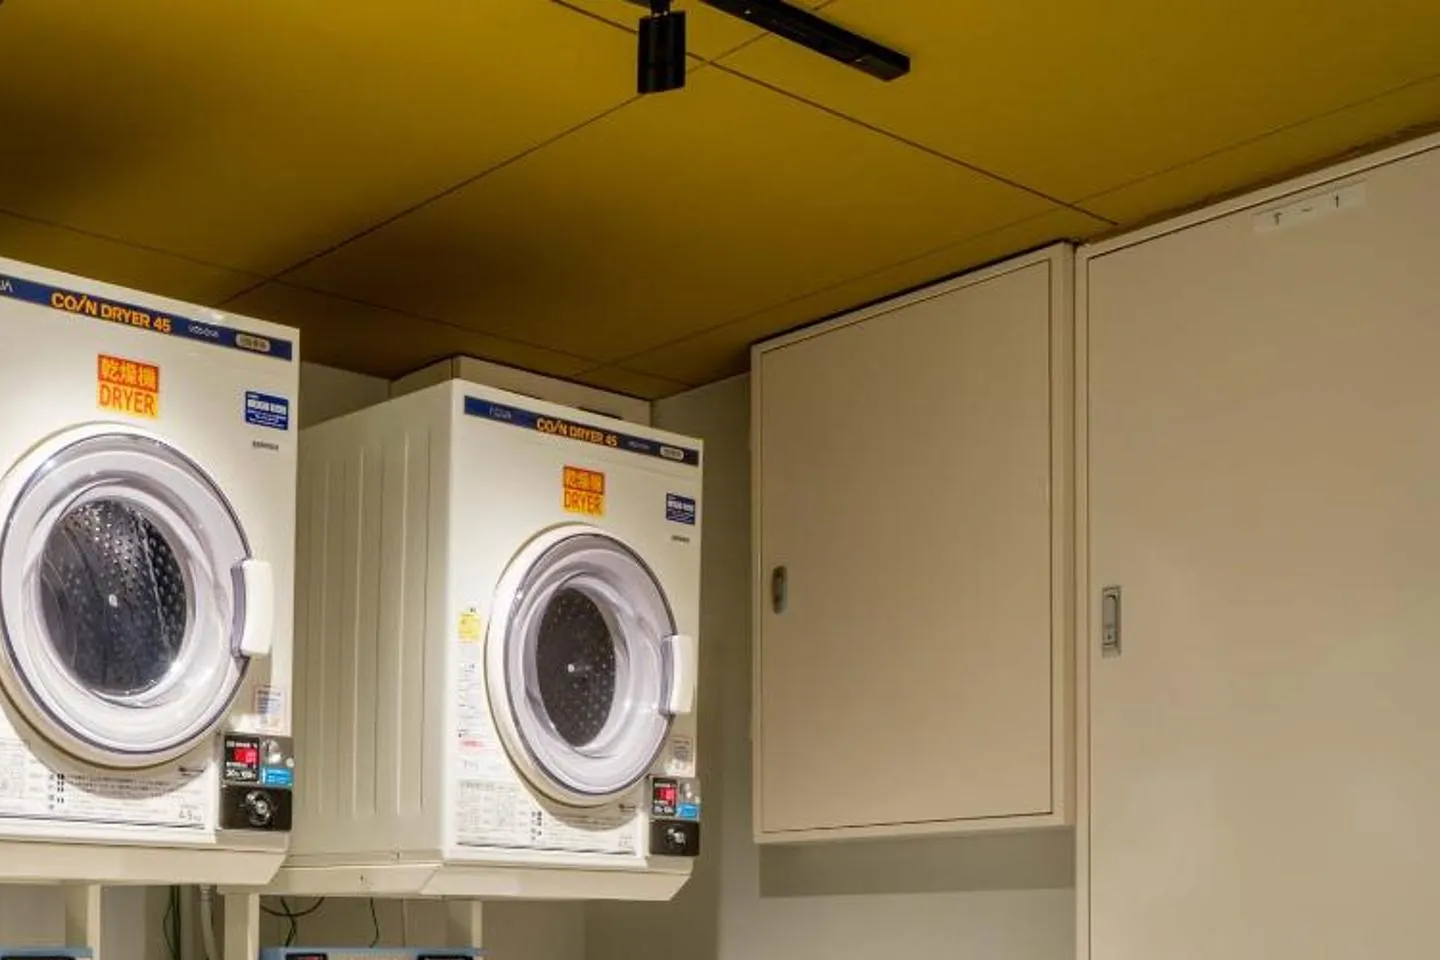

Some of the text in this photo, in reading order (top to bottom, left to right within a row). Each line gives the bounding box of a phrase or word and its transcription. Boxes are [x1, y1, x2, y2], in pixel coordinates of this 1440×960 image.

[101, 305, 151, 328] DRYER
[154, 317, 172, 334] 45
[101, 357, 157, 389] 乾燥機
[100, 386, 155, 416] DRYER
[569, 426, 604, 444] DRYER
[605, 434, 618, 447] 45
[564, 491, 603, 515] DRYER
